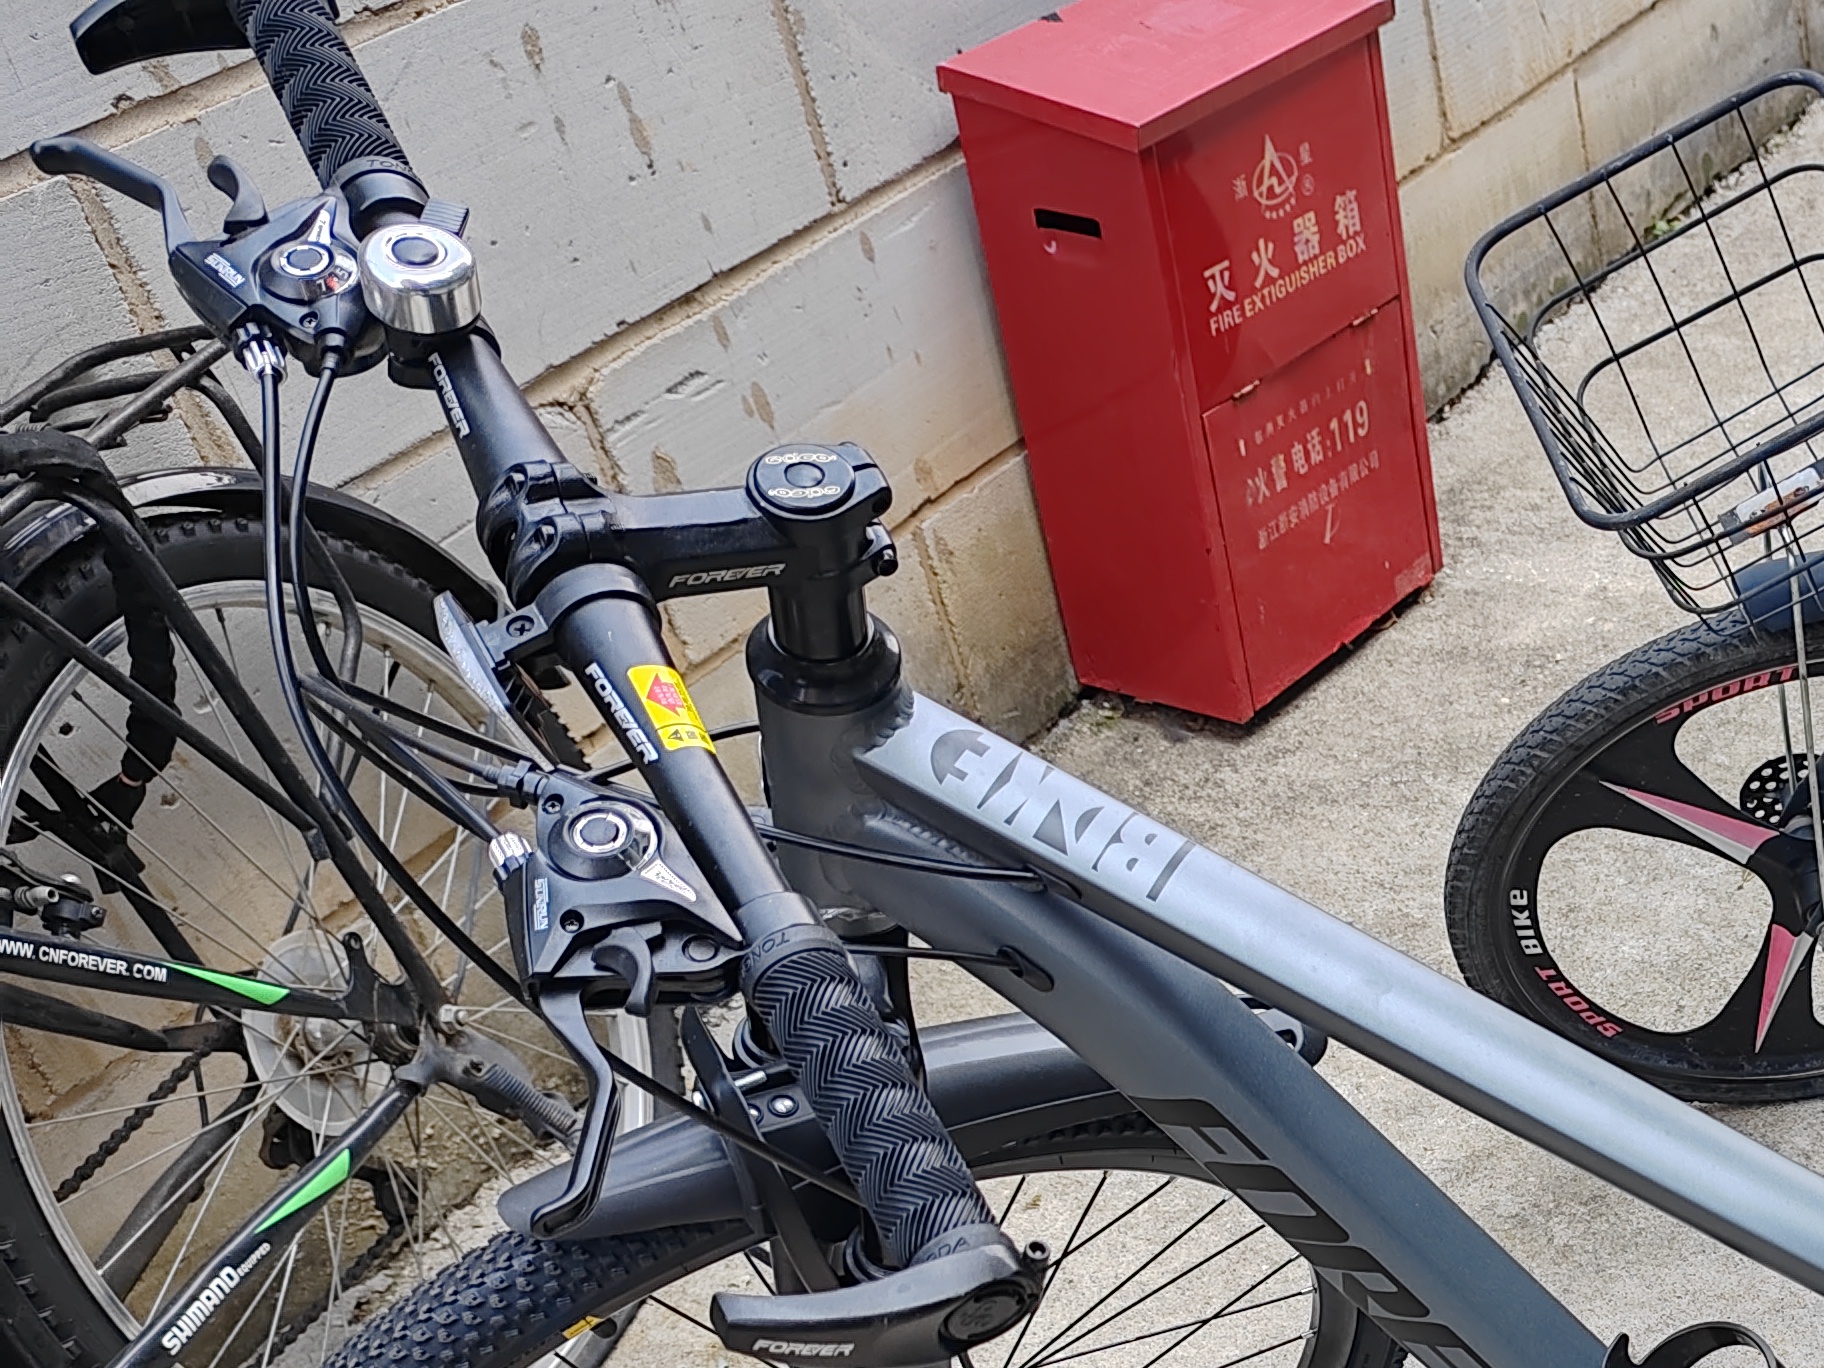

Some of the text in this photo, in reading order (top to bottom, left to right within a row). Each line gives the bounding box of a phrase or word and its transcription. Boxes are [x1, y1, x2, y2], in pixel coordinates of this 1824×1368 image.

[1203, 189, 1362, 313] 灭火器箱
[1209, 232, 1367, 337] FIRE EXTIGUISHER BOX
[427, 351, 471, 440] FOREVER
[668, 563, 787, 589] FOREVER
[584, 661, 659, 765] FOREVER
[1654, 665, 1799, 725] SPORT
[132, 963, 168, 983] COM
[1534, 966, 1624, 1038] SPORT
[161, 1265, 241, 1357] SHIMANO
[752, 1338, 856, 1357] FOREVER
